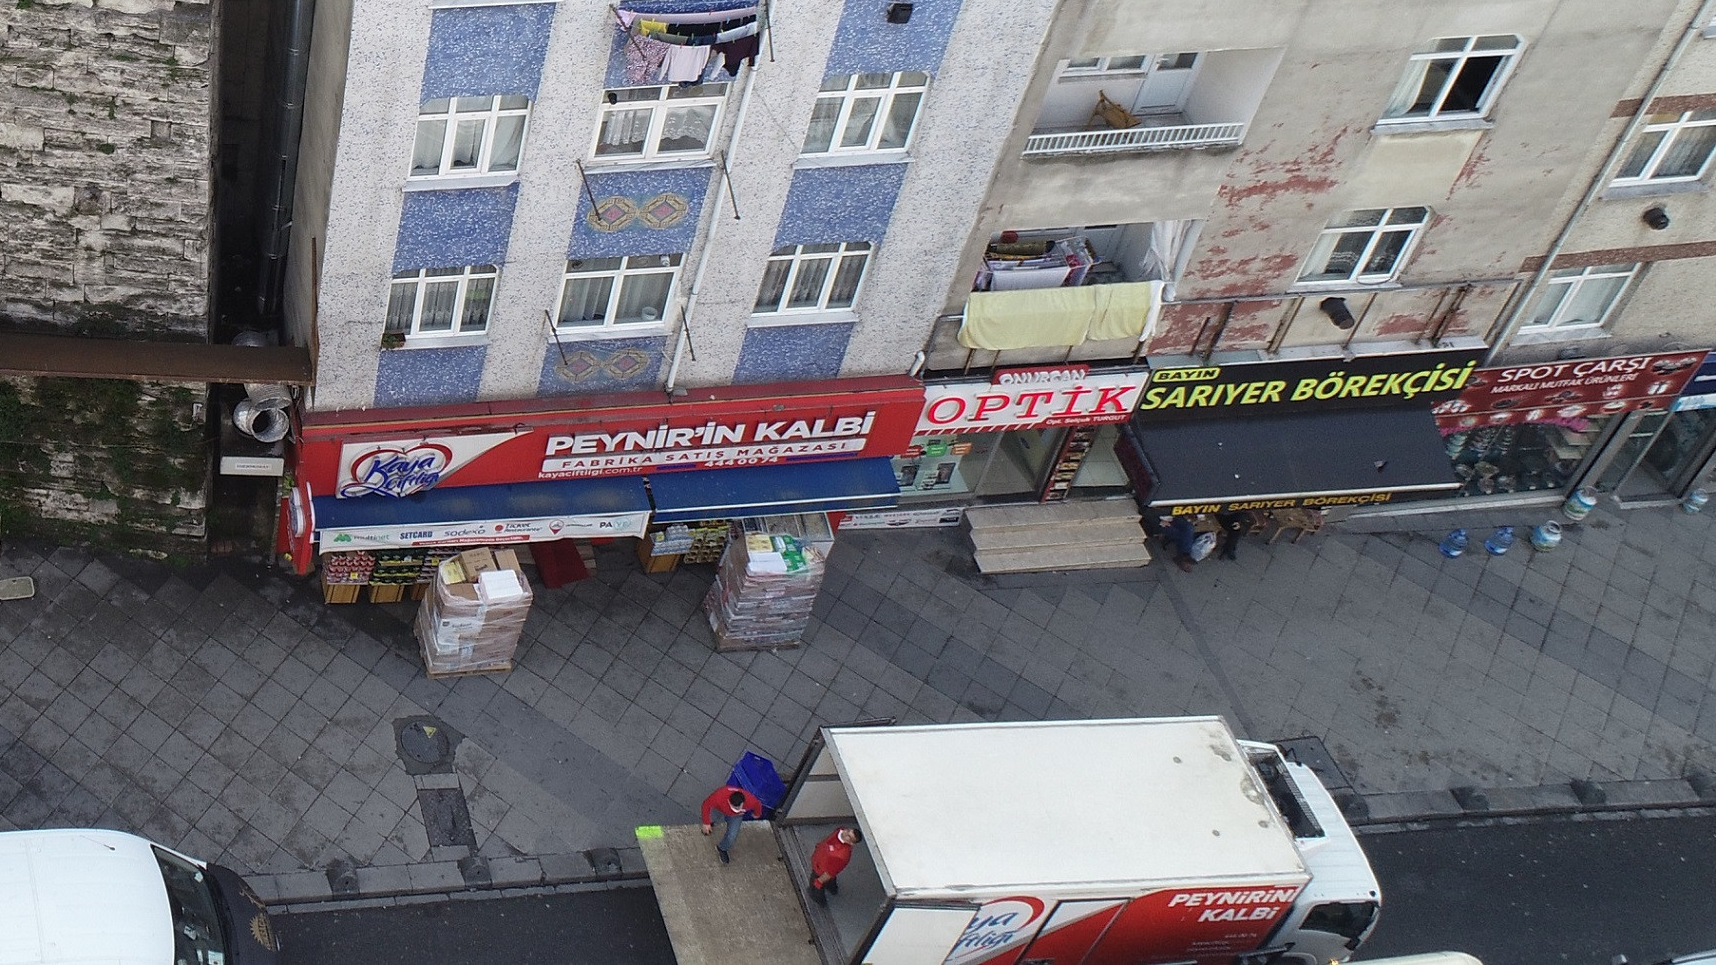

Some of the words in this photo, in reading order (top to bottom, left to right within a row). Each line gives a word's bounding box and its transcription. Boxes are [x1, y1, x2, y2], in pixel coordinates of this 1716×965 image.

[1157, 368, 1218, 381] BAYIN
[1497, 364, 1570, 383] SPOT
[1573, 357, 1654, 378] ÇARŞI
[1140, 380, 1287, 410] SARIYER
[1290, 360, 1478, 400] BÖREKÇİSİ
[927, 385, 1137, 425] OPTİK
[754, 410, 877, 441] KALBİ
[562, 456, 652, 468] FABRİKA
[665, 450, 725, 462] SATIŞ
[737, 442, 847, 456] MAĞAZASI
[1171, 504, 1221, 516] BAYIN
[1227, 498, 1296, 512] SARIYER
[1302, 491, 1392, 507] BÖREKÇİSİ
[400, 530, 433, 540] SETCARD
[1198, 906, 1282, 923] KALBİ
